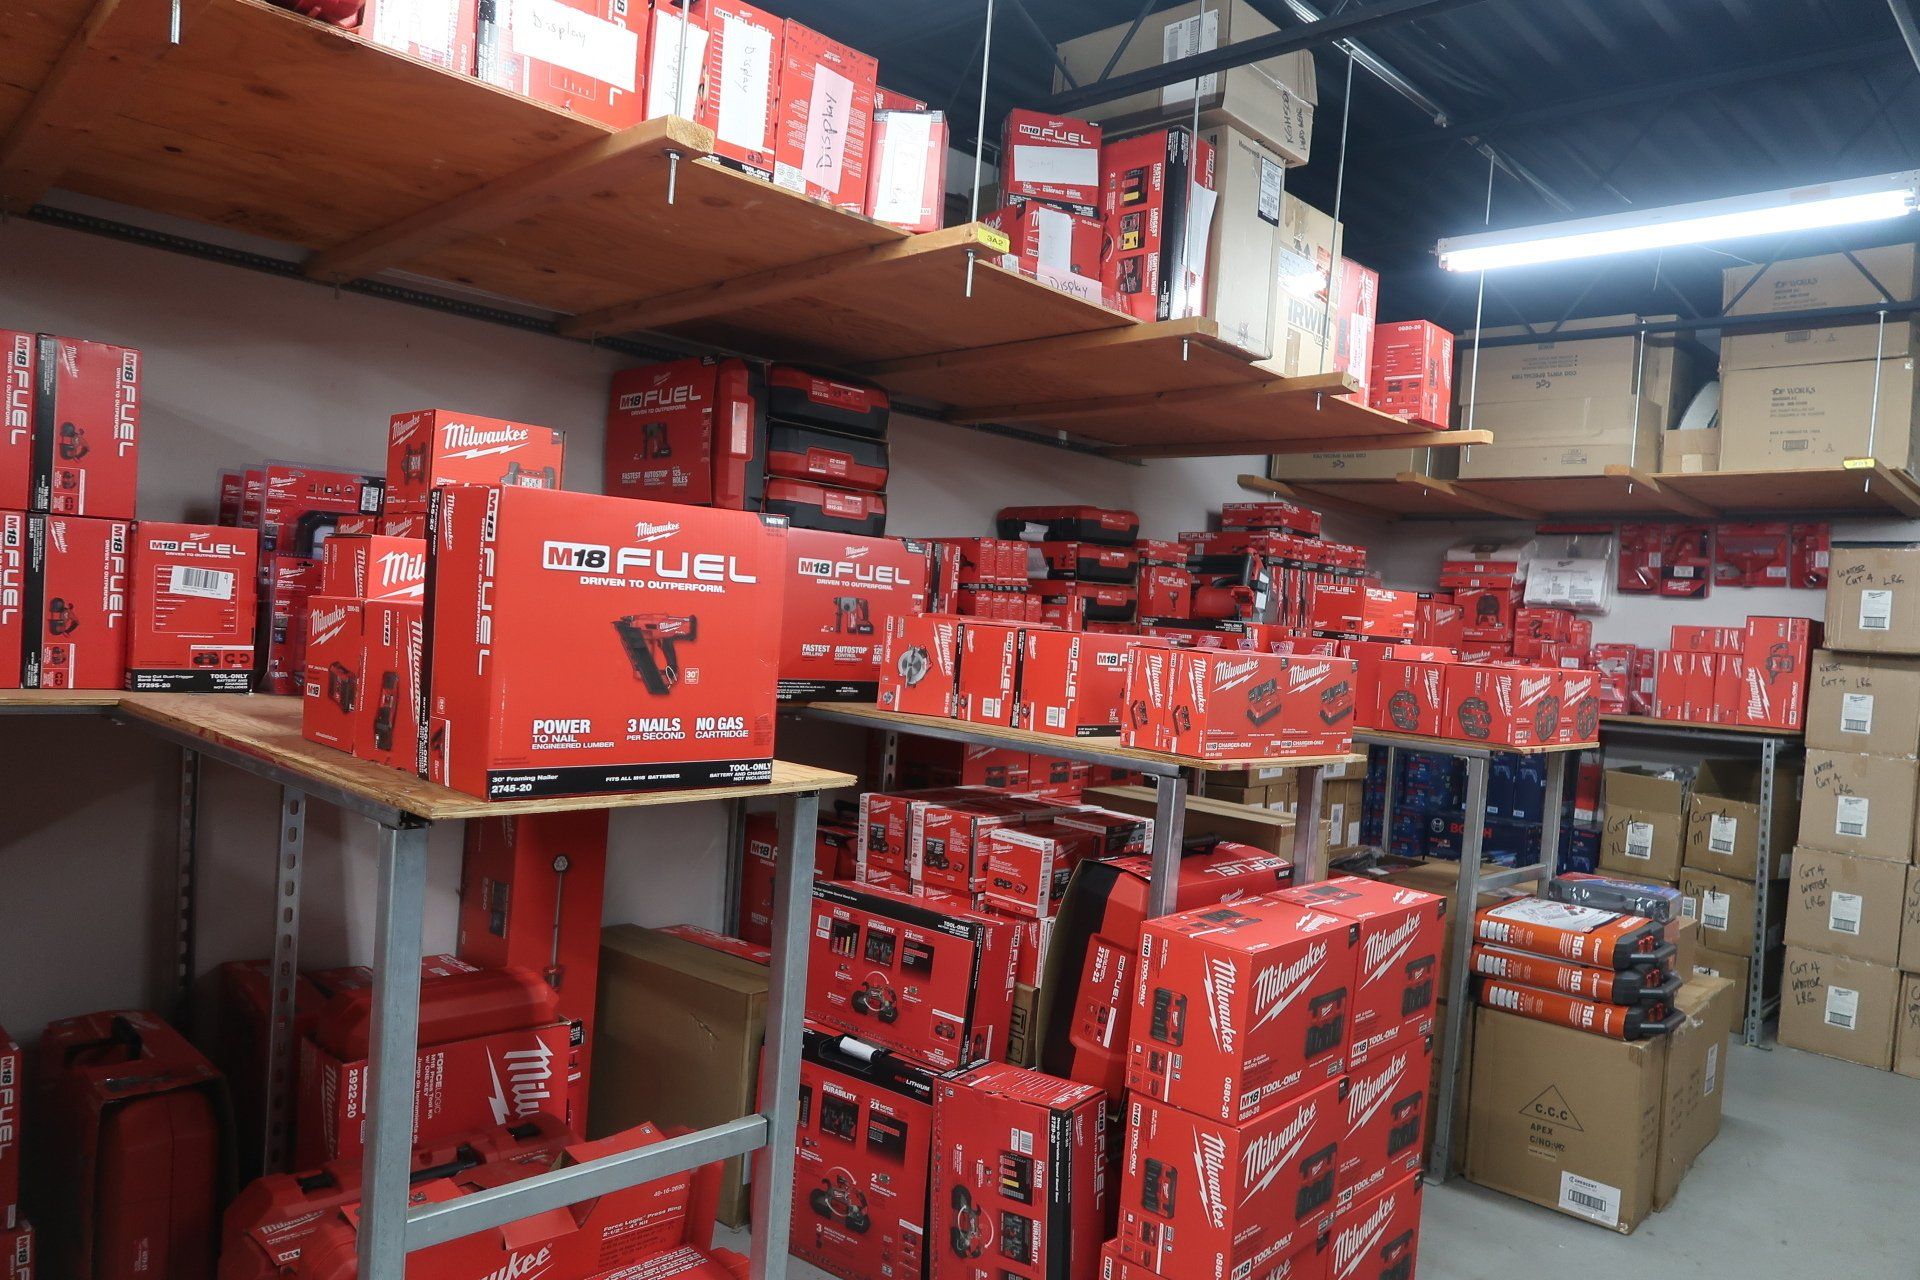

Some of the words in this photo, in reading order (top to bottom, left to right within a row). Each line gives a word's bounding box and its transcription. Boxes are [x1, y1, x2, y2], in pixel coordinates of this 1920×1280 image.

[531, 9, 587, 48] Display
[816, 92, 838, 169] Display
[1019, 123, 1041, 136] M18
[1041, 128, 1092, 145] FUEL
[986, 234, 1004, 247] 3A2
[1049, 275, 1088, 298] Display
[15, 335, 30, 367] M18
[122, 352, 138, 383] M18
[11, 369, 30, 445] FUEL
[619, 392, 642, 411] M18
[644, 385, 701, 407] FUEL
[119, 384, 137, 457] FUEL
[391, 414, 421, 441] Milwaukee
[440, 421, 529, 450] Milwaukee
[485, 489, 500, 542] M18
[634, 520, 681, 537] Milwaukee
[765, 516, 785, 525] NEW
[5, 515, 20, 546] M18
[111, 523, 126, 553] M18
[479, 518, 487, 550] DRIVEN
[150, 540, 178, 551] M18
[181, 541, 246, 556] FUEL
[478, 552, 485, 566] TO
[542, 541, 611, 573] M18
[616, 548, 757, 585] FUEL
[798, 557, 833, 577] M18
[834, 561, 911, 586] FUEL
[2, 549, 20, 625] FUEL
[108, 555, 125, 629] FUEL
[579, 576, 626, 588] DRIVEN
[628, 578, 646, 588] TO
[647, 580, 726, 594] OUTPERFORM.
[816, 578, 840, 586] DRIVEN
[840, 580, 850, 588] TO
[850, 581, 893, 591] OUTPERFORM.
[310, 604, 347, 637] Milwaukee
[475, 567, 484, 645] OUTPERFORM.
[478, 547, 495, 676] FUEL
[802, 643, 831, 653] FASTEST
[834, 645, 868, 655] AUTOSTOP
[938, 622, 953, 676] Milwaukee
[1006, 631, 1014, 651] M18
[1072, 637, 1080, 659] M18
[1097, 652, 1119, 667] M18
[1213, 657, 1260, 685] Milwaukee
[1287, 660, 1331, 687] Milwaukee
[1001, 652, 1013, 701] FUEL
[1067, 659, 1079, 710] FUEL
[1149, 654, 1163, 709] Milwaukee
[1192, 657, 1206, 715] Milwaukee
[1428, 668, 1438, 709] Milwaukee
[1519, 674, 1551, 700] Milwaukee
[1564, 676, 1592, 700] Milwaukee
[1500, 674, 1512, 717] Milwaukee
[1746, 667, 1764, 721] Milwaukee
[532, 718, 591, 735] POWER
[626, 718, 638, 733] 3
[638, 717, 681, 733] NAILS
[626, 733, 641, 742] PER
[642, 731, 686, 741] SECOND
[694, 728, 750, 739] CARTRIDGE
[695, 716, 716, 731] NO
[716, 716, 744, 731] GAS
[531, 742, 582, 750] ENGINEERED
[582, 740, 615, 749] LUMBER
[532, 734, 549, 744] TO
[550, 734, 578, 744] NAIL
[647, 773, 680, 781] BATTERIES
[709, 771, 732, 779] BATTERY
[729, 762, 772, 773] TOOL-ONLY
[745, 774, 772, 782] INCLUDED
[490, 783, 533, 794] 2745-20
[751, 840, 772, 859] M18
[833, 908, 850, 919] FASTER
[867, 920, 895, 934] DURABILITY
[943, 920, 969, 932] TOOL-ONLY
[1142, 933, 1152, 957] M18
[1361, 910, 1421, 975] Milwaukee
[1091, 946, 1107, 983] 2729-22
[1118, 955, 1126, 971] M18
[1250, 938, 1329, 1016] Milwaukee
[1810, 961, 1821, 974] 4
[1110, 970, 1125, 1005] FUEL
[1138, 959, 1150, 1009] TOOL-ONLY
[1211, 948, 1238, 1057] Milwaukee
[1351, 1038, 1368, 1058] M18
[1368, 1025, 1400, 1046] TOOL-ONLY
[346, 1068, 358, 1119] 2922-20
[433, 1052, 444, 1115] FORCELOGIC
[822, 1084, 857, 1102] DURABILITY
[1221, 1077, 1233, 1119] 0880-20
[1240, 1086, 1261, 1111] M18
[1262, 1069, 1303, 1095] TOOL-ONLY
[1346, 1050, 1408, 1125] Milwaukee
[1098, 1100, 1106, 1132] M18
[1132, 1102, 1142, 1127] M18
[1238, 1105, 1261, 1122] 0880-20
[1534, 1103, 1569, 1121] C.C.C
[1530, 1122, 1554, 1136] APEX
[1131, 1127, 1139, 1177] TOOL-ONLY
[1240, 1098, 1318, 1190] Milwaukee
[1034, 1160, 1043, 1189] FASTER
[1096, 1133, 1105, 1211] FUEL
[1200, 1131, 1228, 1230] Milwaukee
[1336, 1186, 1353, 1207] M18
[1353, 1166, 1386, 1192] TOOL-ONLY
[1032, 1219, 1040, 1264] DURABILITY
[1331, 1192, 1396, 1276] Milwaukee
